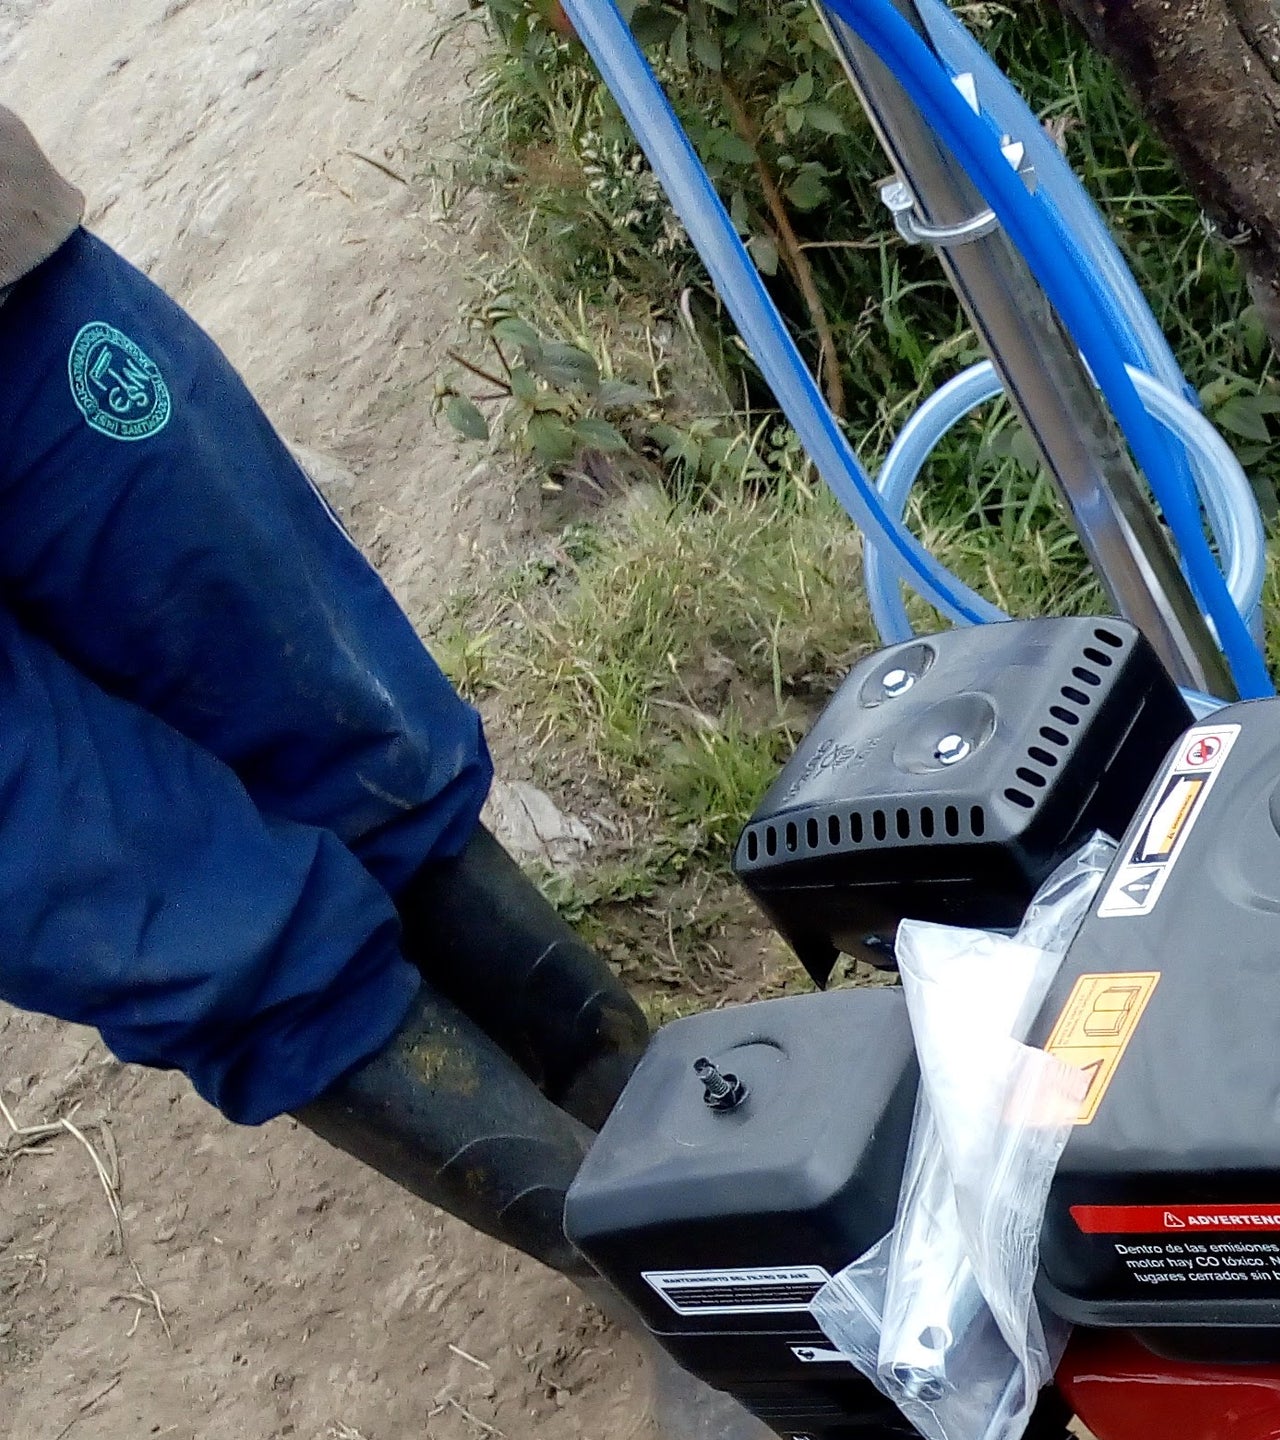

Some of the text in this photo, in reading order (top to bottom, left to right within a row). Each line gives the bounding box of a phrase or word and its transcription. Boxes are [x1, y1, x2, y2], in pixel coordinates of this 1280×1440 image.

[1114, 1244, 1163, 1254] Dentro
[1165, 1243, 1184, 1253] de
[1184, 1243, 1207, 1253] las
[1209, 1242, 1280, 1253] emisiones
[1126, 1259, 1165, 1268] motor
[1166, 1257, 1193, 1269] hay
[1196, 1256, 1219, 1267] CO
[1221, 1256, 1269, 1267] tóxico.
[1133, 1272, 1186, 1284] lugares
[1188, 1270, 1248, 1281] cerrados
[1250, 1270, 1271, 1281] sin
